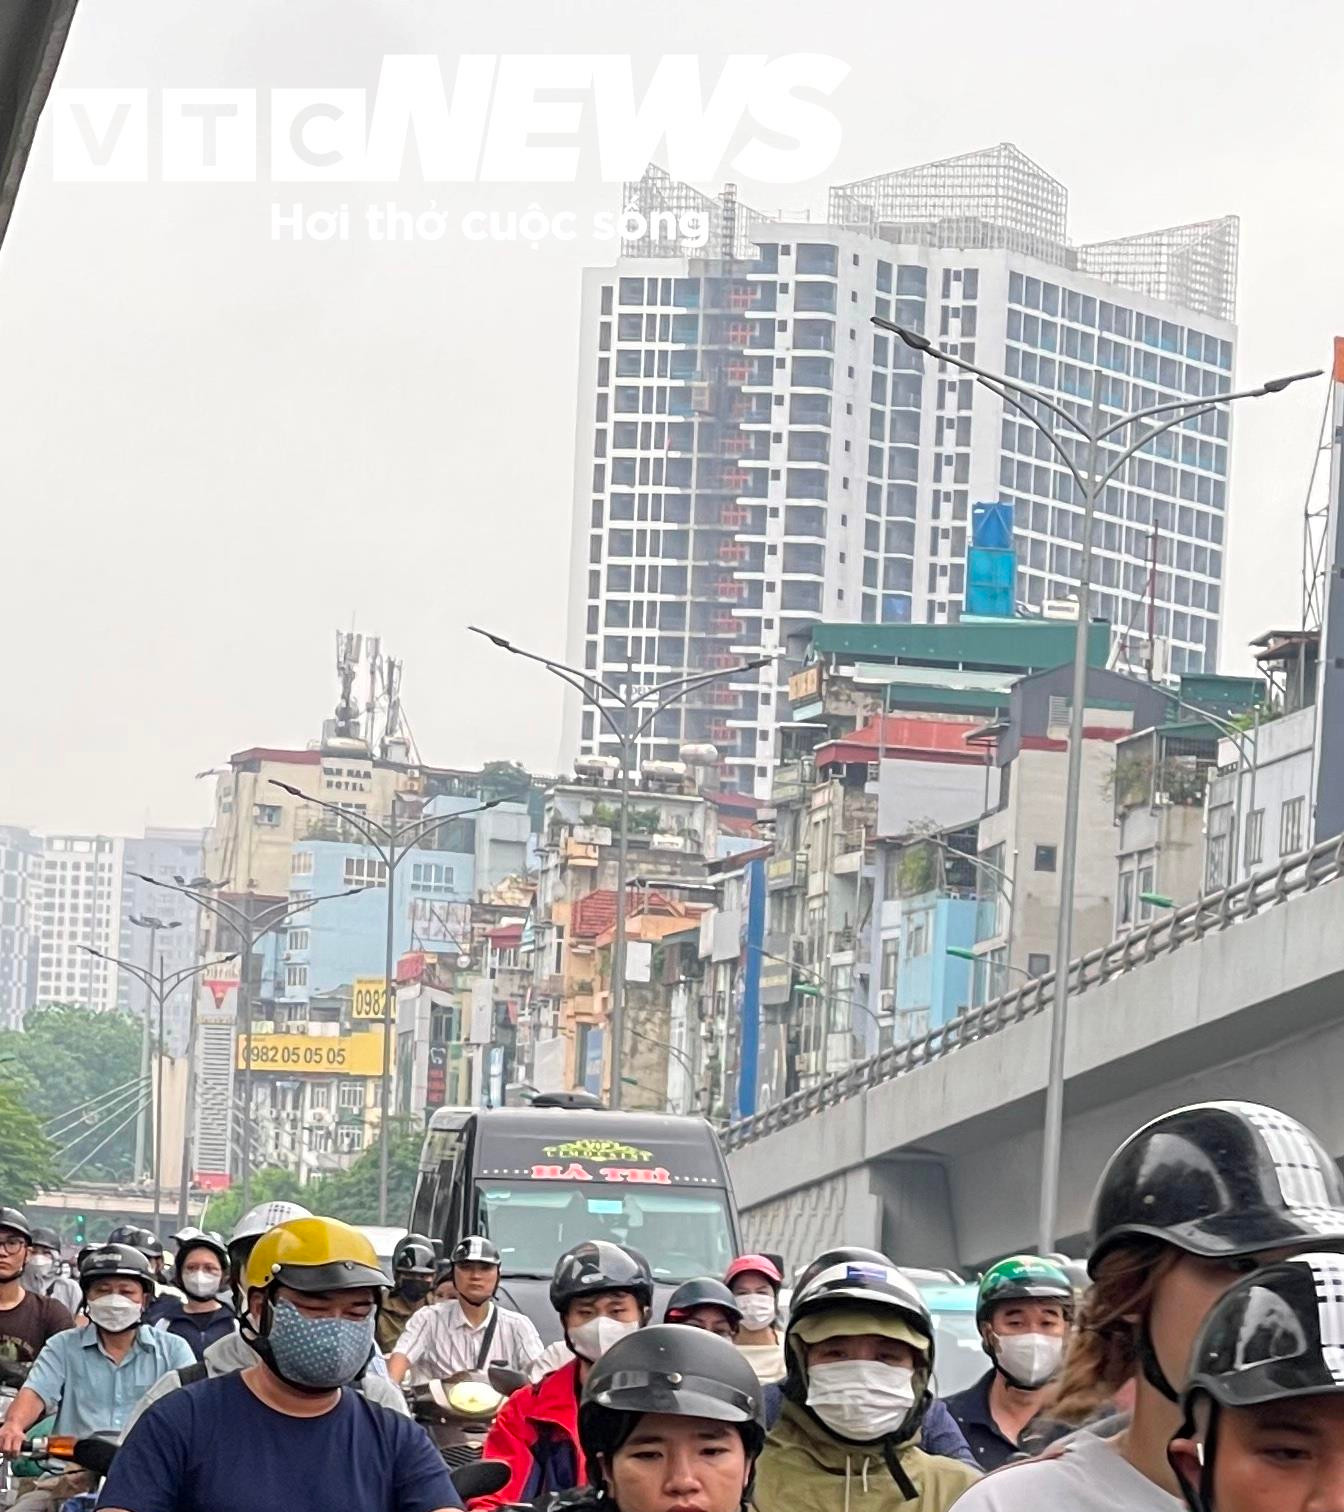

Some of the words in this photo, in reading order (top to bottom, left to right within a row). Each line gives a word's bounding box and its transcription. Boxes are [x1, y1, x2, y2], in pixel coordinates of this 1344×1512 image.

[281, 1046, 301, 1064] 05
[304, 1047, 323, 1065] 05
[326, 1048, 346, 1065] 05
